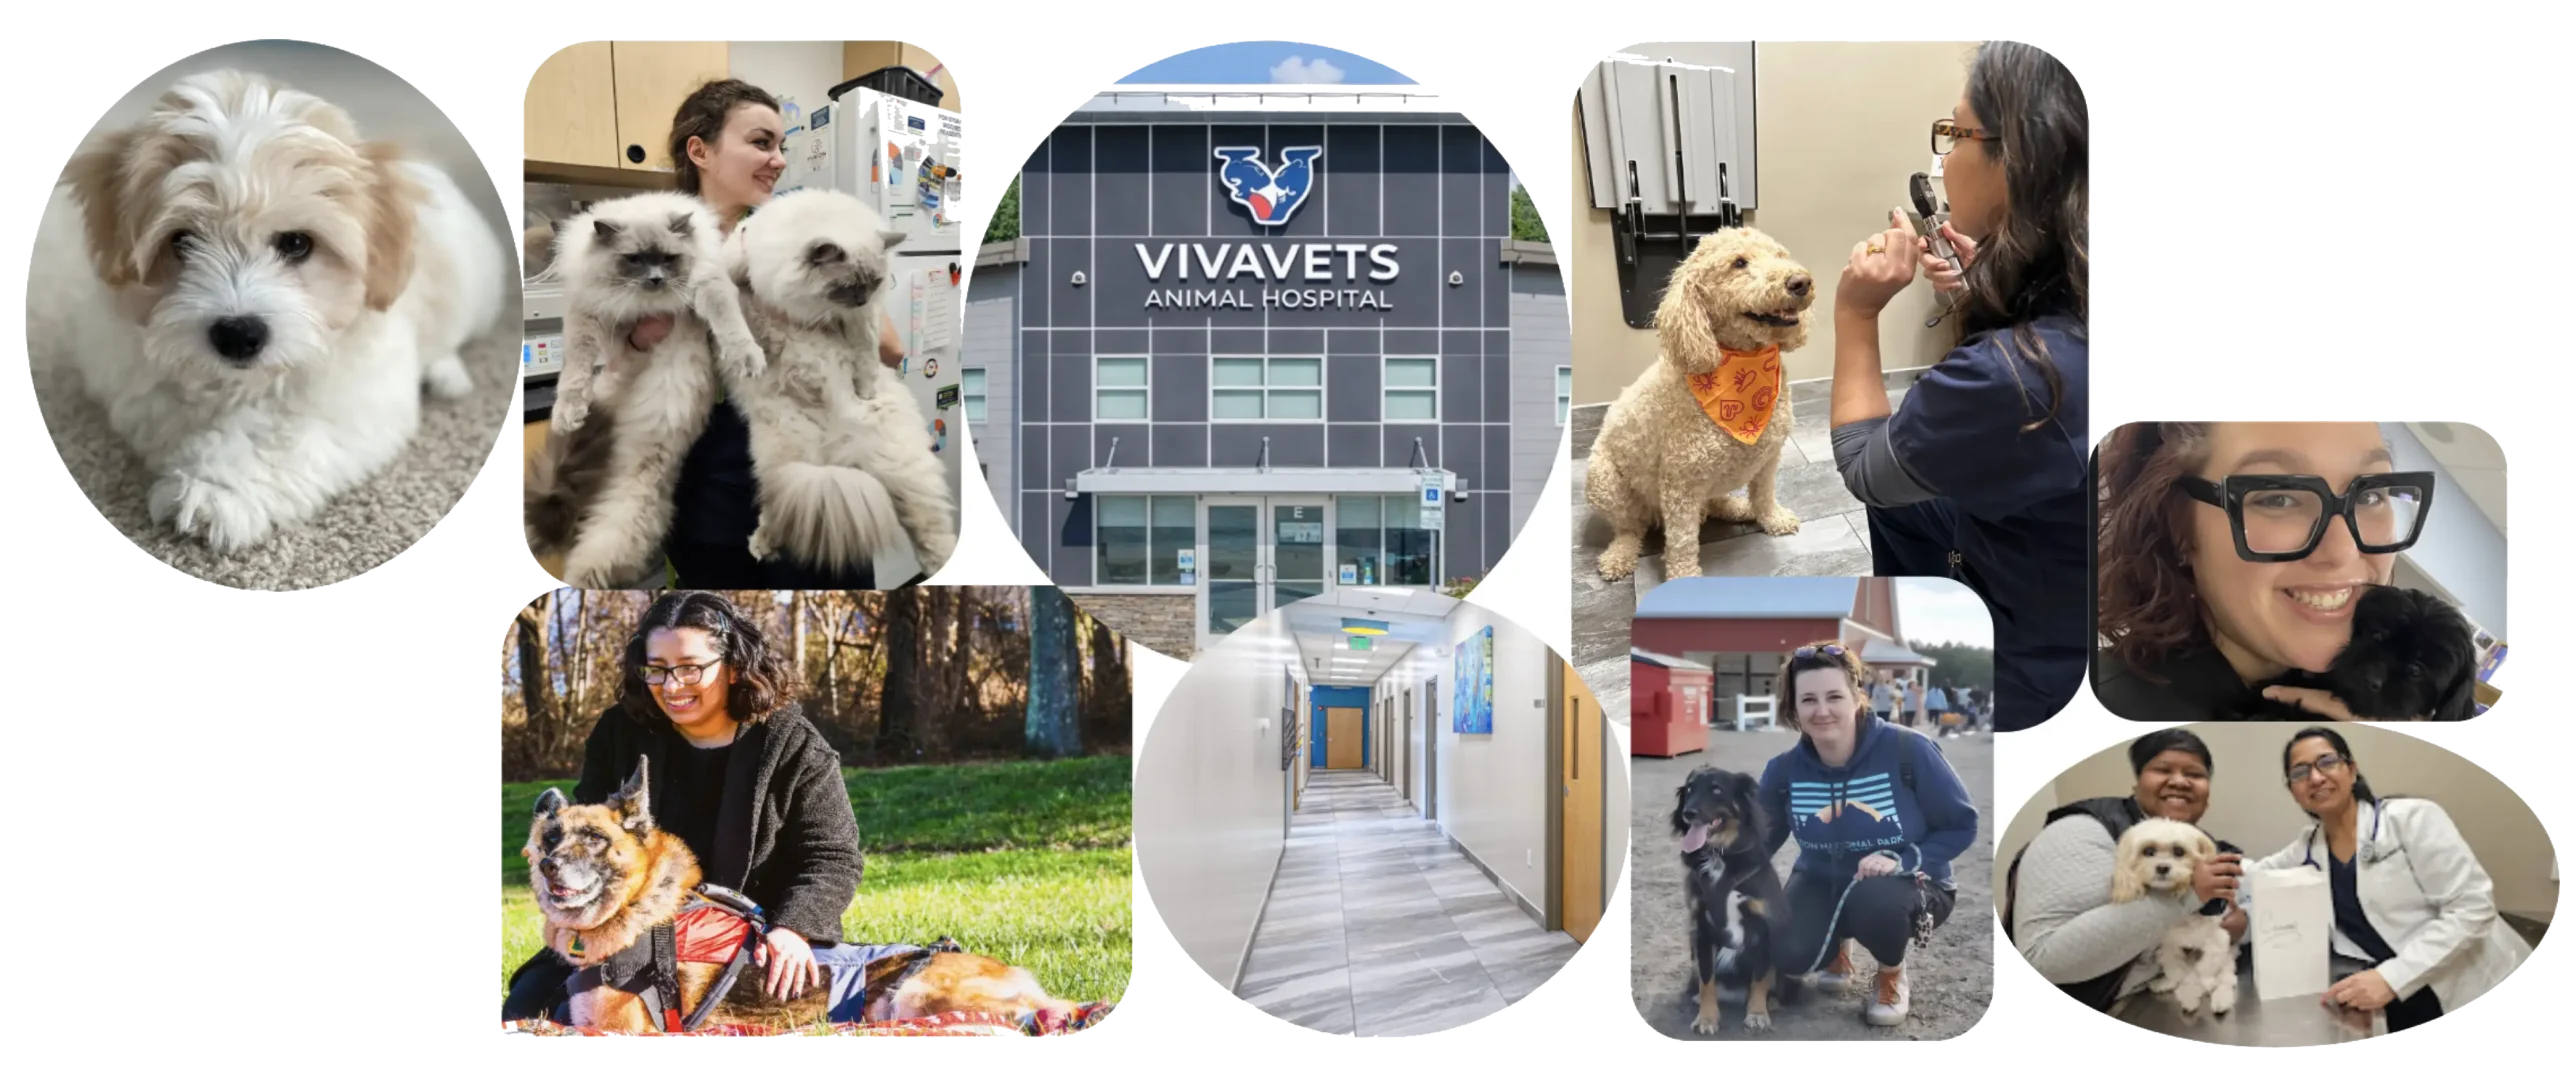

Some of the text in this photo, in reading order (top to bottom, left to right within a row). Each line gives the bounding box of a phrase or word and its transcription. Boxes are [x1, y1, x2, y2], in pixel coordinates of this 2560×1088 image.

[1134, 243, 1400, 280] VIVAVETS
[1144, 289, 1393, 308] ANIMAL HOSPITAL
[1294, 506, 1303, 518] E
[1820, 839, 1875, 849] NATONAL
[1877, 834, 1904, 846] PARK
